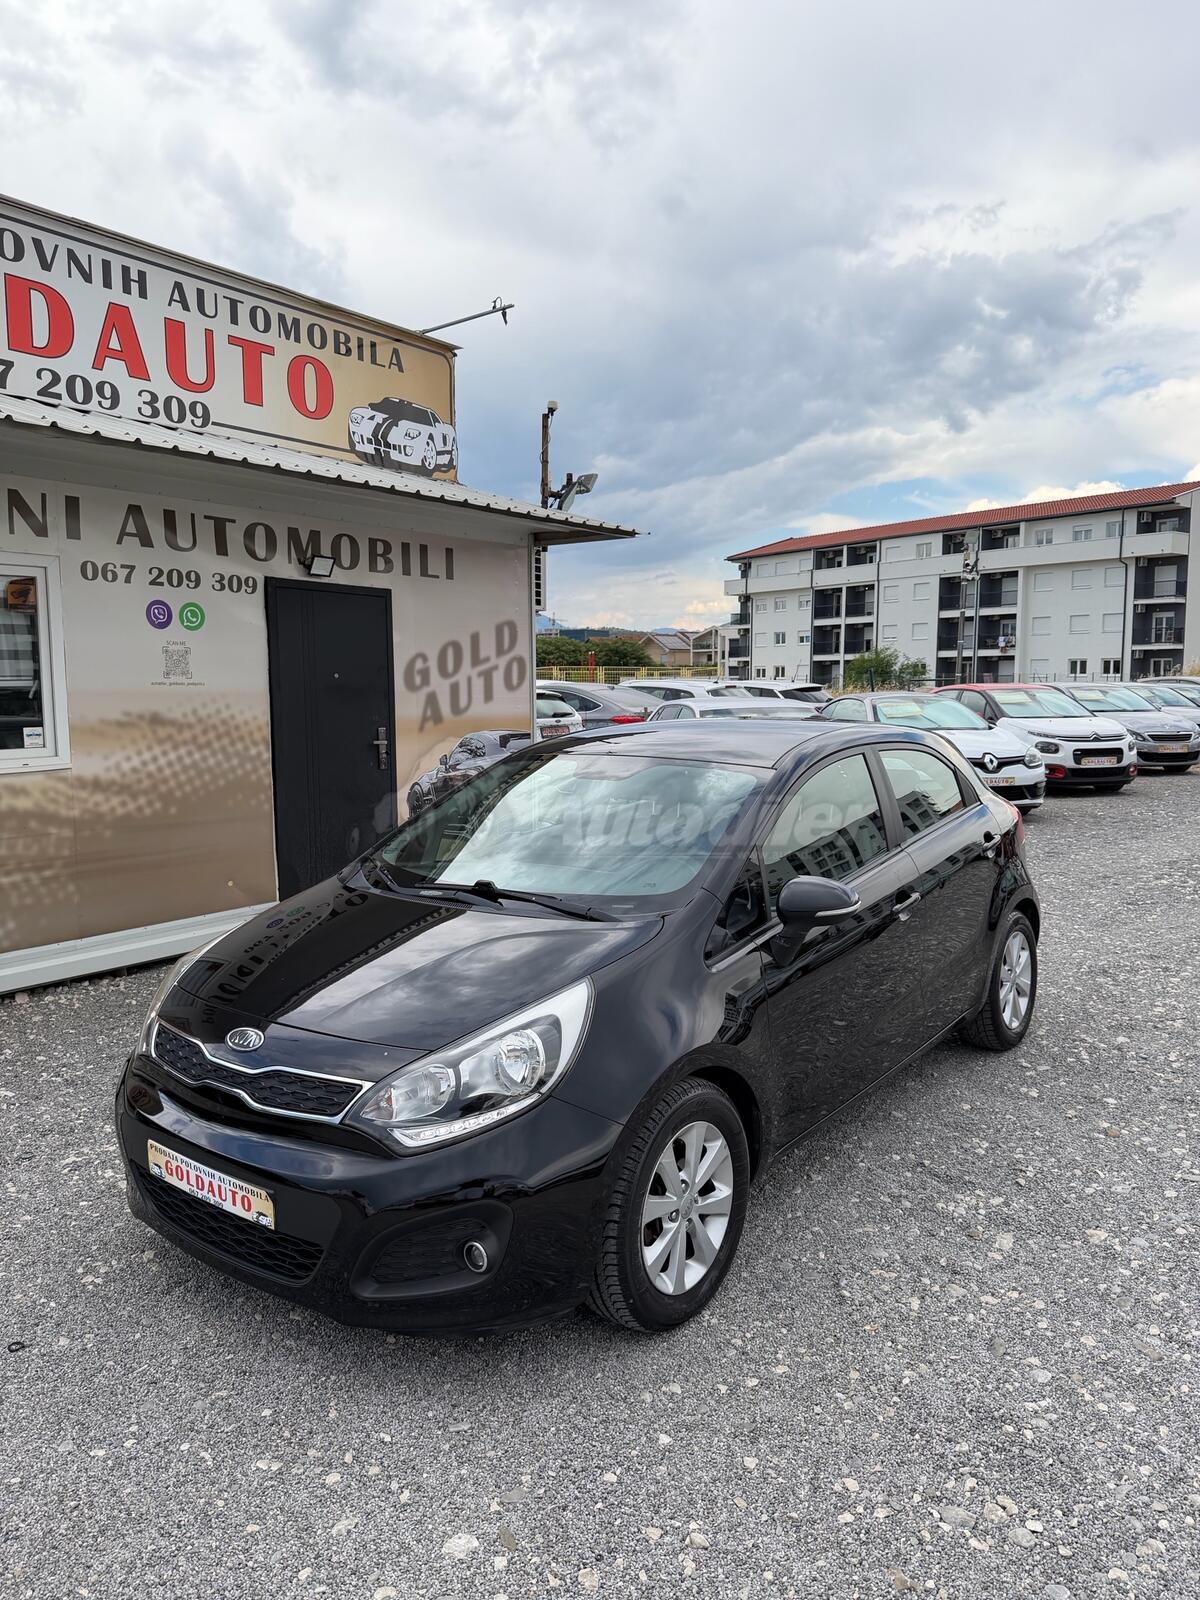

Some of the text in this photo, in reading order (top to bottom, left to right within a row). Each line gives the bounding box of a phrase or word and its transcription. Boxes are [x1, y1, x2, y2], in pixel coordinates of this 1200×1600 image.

[0, 227, 405, 373] OVNIH AUTOMOBILA
[4, 272, 334, 420] DAUTO
[36, 367, 121, 411] 209
[137, 389, 211, 429] 309
[7, 487, 455, 580] NI AUTOMOBILI
[80, 560, 258, 595] 067 209 309
[403, 619, 518, 693] GOLD
[418, 654, 528, 733] AUTO
[150, 1143, 270, 1203] PRODAJA POLOVNIH AUTOMOBILA
[164, 1159, 252, 1213] GOLDAUTO
